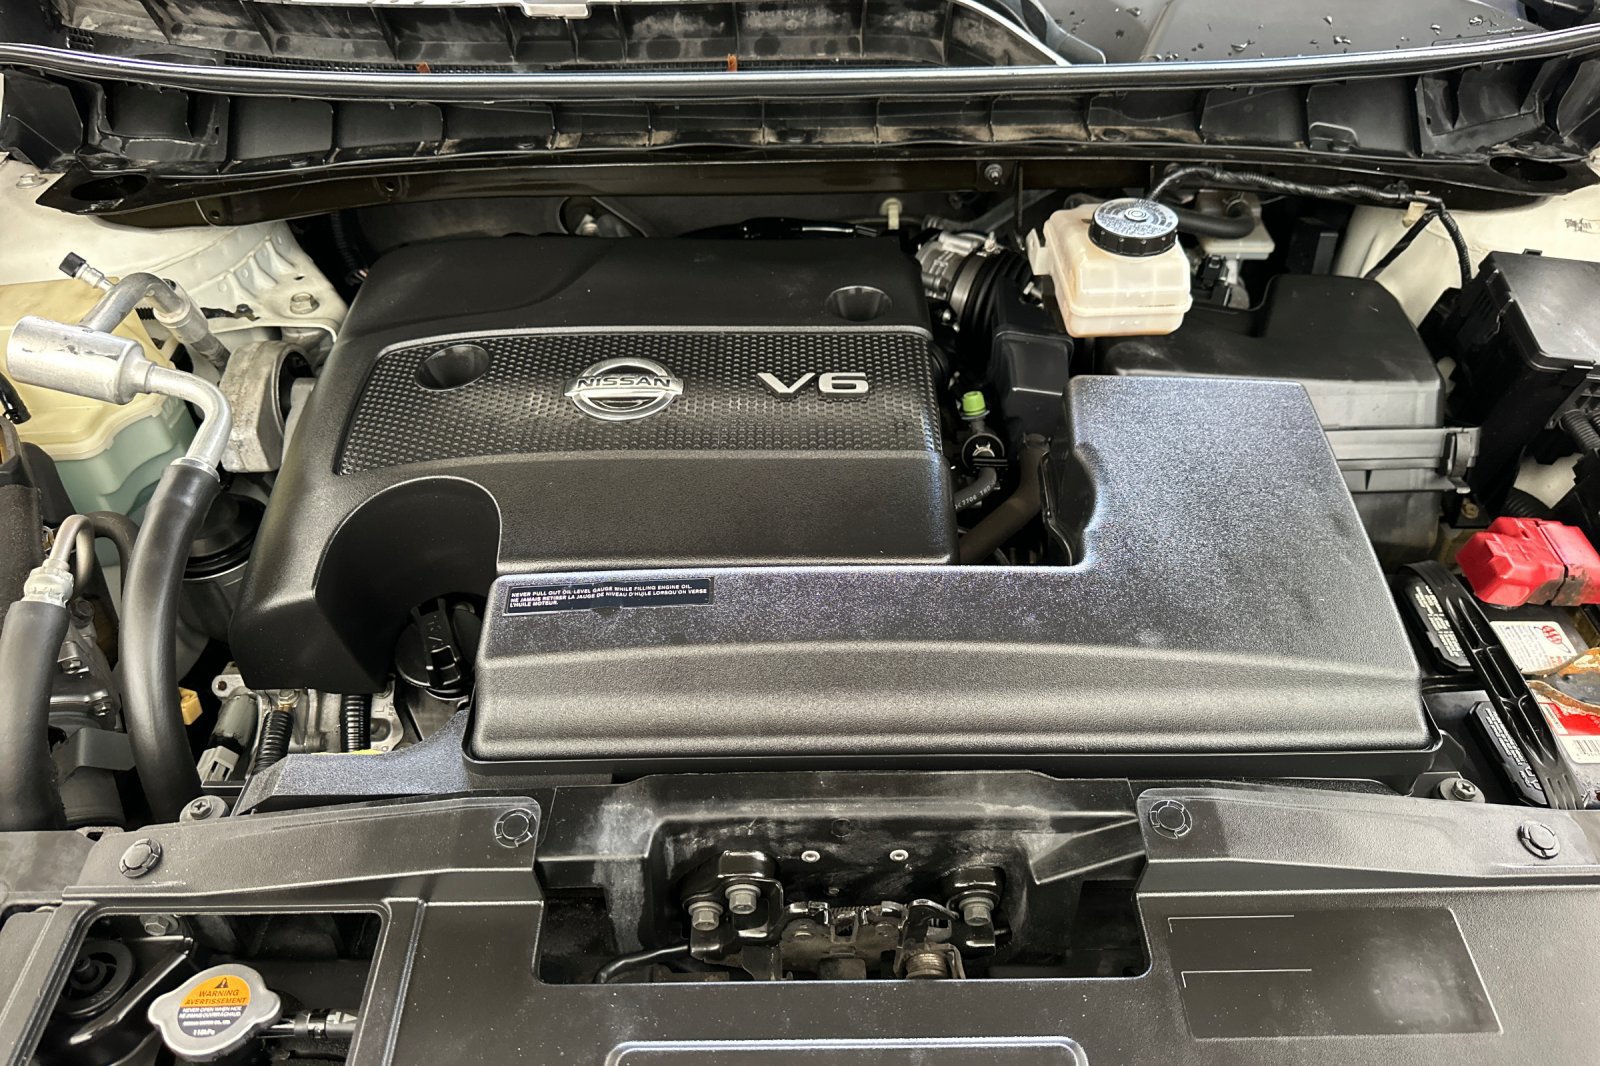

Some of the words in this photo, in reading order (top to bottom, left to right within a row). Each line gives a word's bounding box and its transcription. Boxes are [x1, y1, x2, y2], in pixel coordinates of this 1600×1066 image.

[577, 375, 671, 388] NISSAN
[757, 372, 869, 397] V6
[199, 989, 240, 997] WARNING
[184, 997, 247, 1005] AVERTISSEMENT
